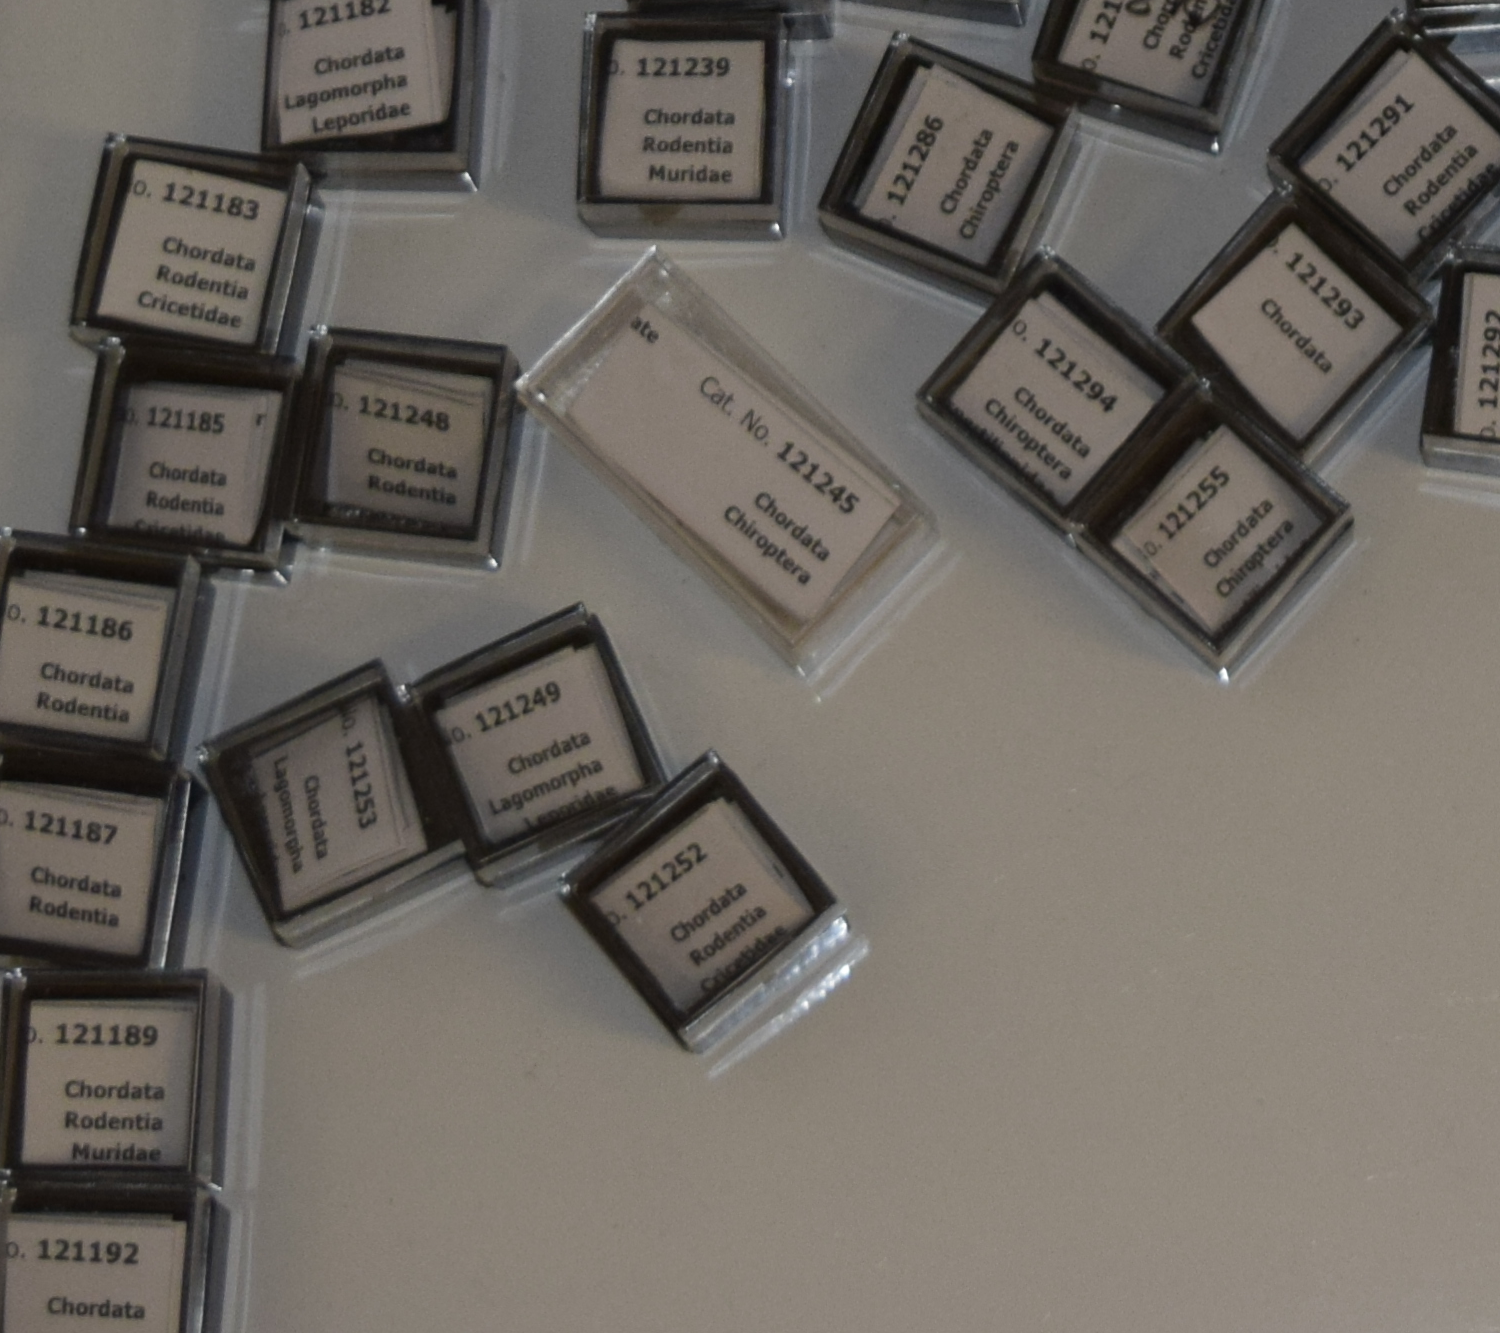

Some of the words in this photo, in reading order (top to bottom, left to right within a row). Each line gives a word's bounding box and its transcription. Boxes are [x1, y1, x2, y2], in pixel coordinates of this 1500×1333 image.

[314, 47, 405, 75] Chordata
[637, 57, 729, 78] 121239
[284, 75, 408, 110] Lagomorpha
[643, 109, 735, 125] Chordata
[1336, 94, 1414, 172] 121291
[642, 136, 733, 154] Rodentia
[887, 115, 943, 206] 121286
[648, 165, 732, 184] Muridae
[162, 182, 259, 220] 121183
[162, 237, 256, 272] Chordata
[156, 265, 248, 300] Rodentia
[1285, 252, 1365, 330] 121293
[137, 291, 241, 328] Cricetidae
[1034, 338, 1118, 413] 121294
[777, 442, 859, 514] 121245
[1158, 465, 1229, 540] 121255
[37, 606, 132, 641] 121186
[40, 663, 134, 694] Chordata
[36, 692, 129, 723] Rodentia
[475, 682, 560, 733] 121249
[507, 733, 591, 774] Chordata
[345, 742, 377, 830] 121253
[488, 760, 603, 816] Lagomorpha
[24, 810, 118, 845] 121187
[304, 775, 328, 860] Chordata
[30, 866, 121, 898] Chordata
[625, 843, 707, 911] 121252
[29, 895, 119, 928] Rodentia
[670, 884, 747, 943] Chordata
[689, 907, 767, 967] Rodentia
[56, 1023, 157, 1046] 121189
[64, 1080, 165, 1101] Chordata
[64, 1111, 163, 1132] Rodentia
[72, 1143, 160, 1161] Muridae
[38, 1239, 138, 1265] 121192
[47, 1297, 145, 1320] Chordata
